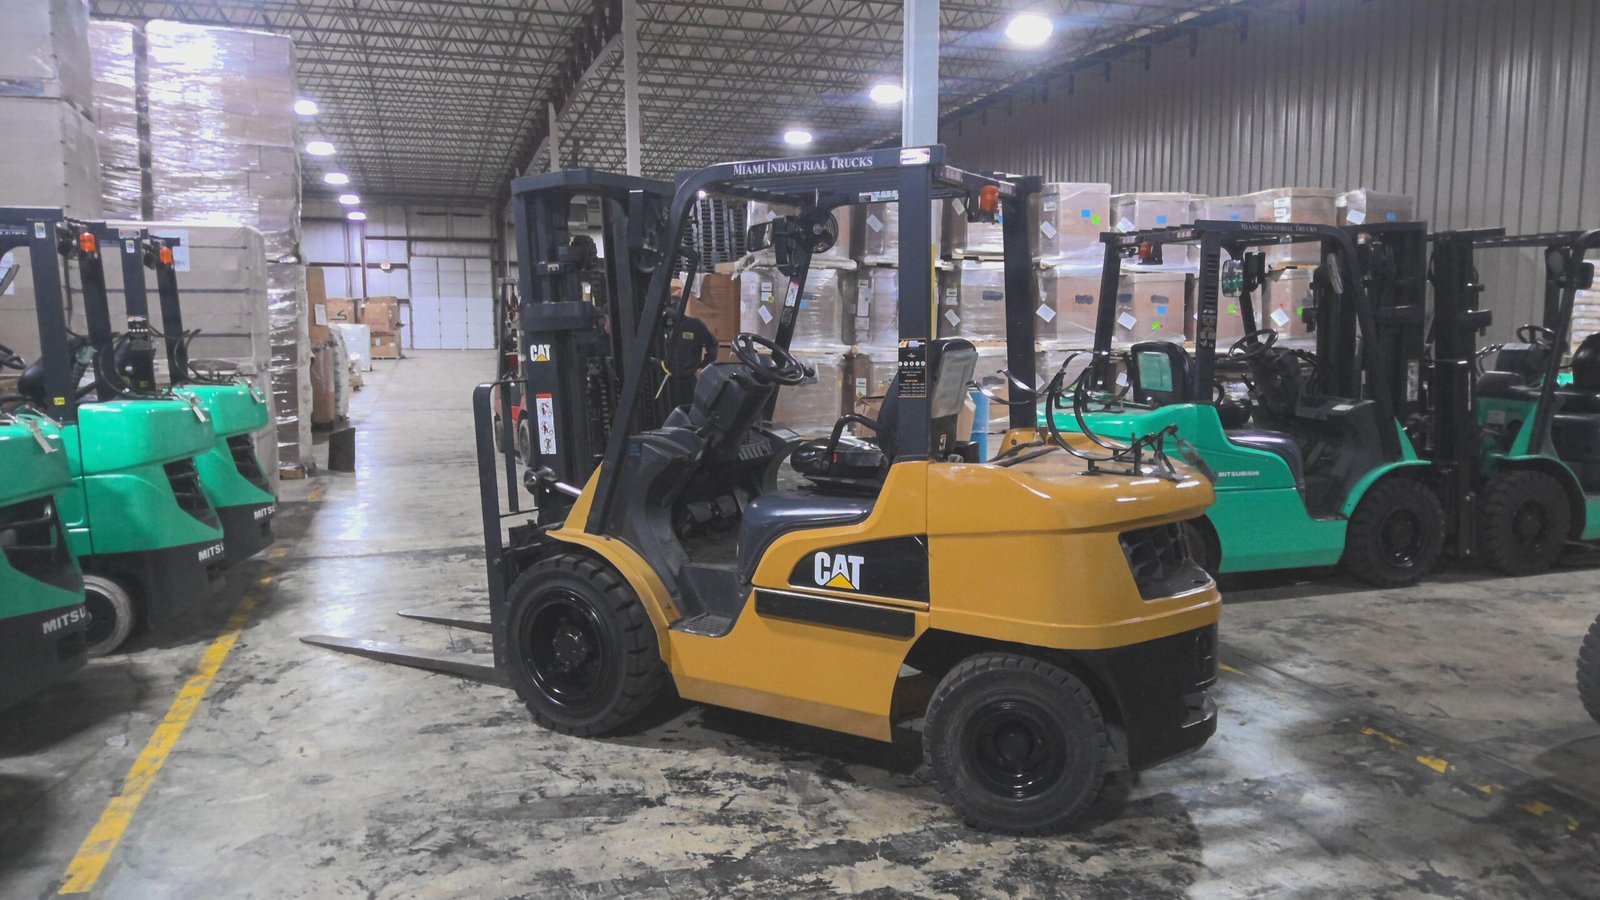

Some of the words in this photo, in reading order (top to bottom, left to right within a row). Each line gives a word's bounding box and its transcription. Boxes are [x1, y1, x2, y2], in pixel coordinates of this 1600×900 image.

[733, 163, 765, 176] MIAMI
[767, 159, 828, 173] INDUSTRIAL
[830, 155, 873, 169] TRUCKS
[530, 344, 551, 361] CAT
[815, 551, 864, 590] CAT
[42, 606, 86, 634] MITSU
